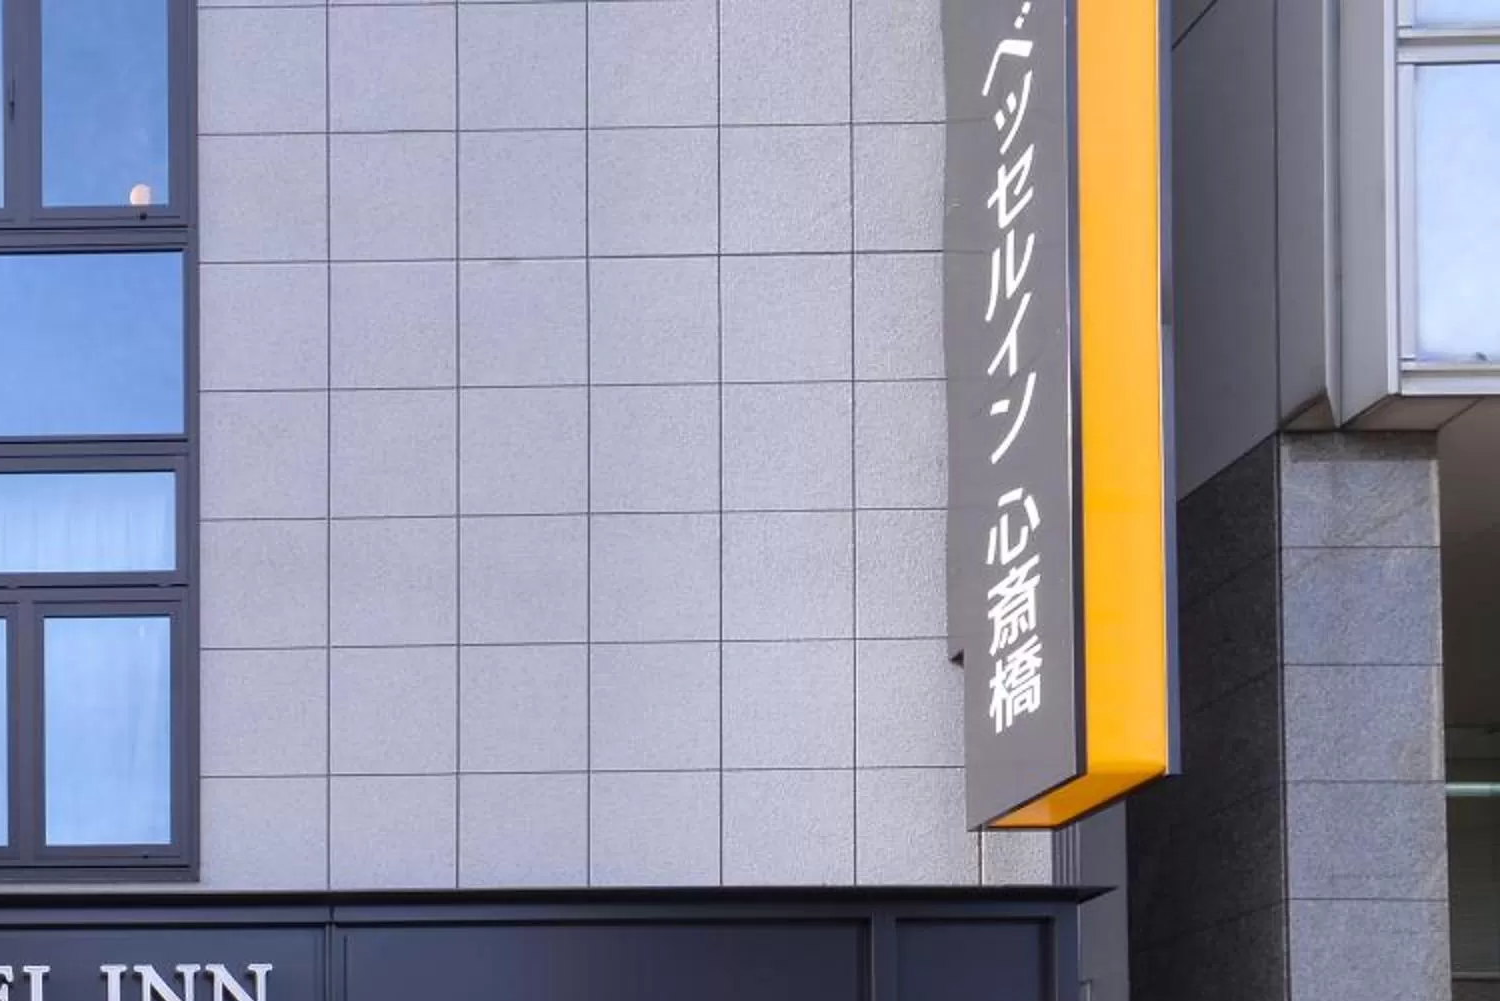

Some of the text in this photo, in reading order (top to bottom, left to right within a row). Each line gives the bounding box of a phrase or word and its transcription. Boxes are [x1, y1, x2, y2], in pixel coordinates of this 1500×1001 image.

[980, 1, 1043, 734] ベッセルイン 心斎橋
